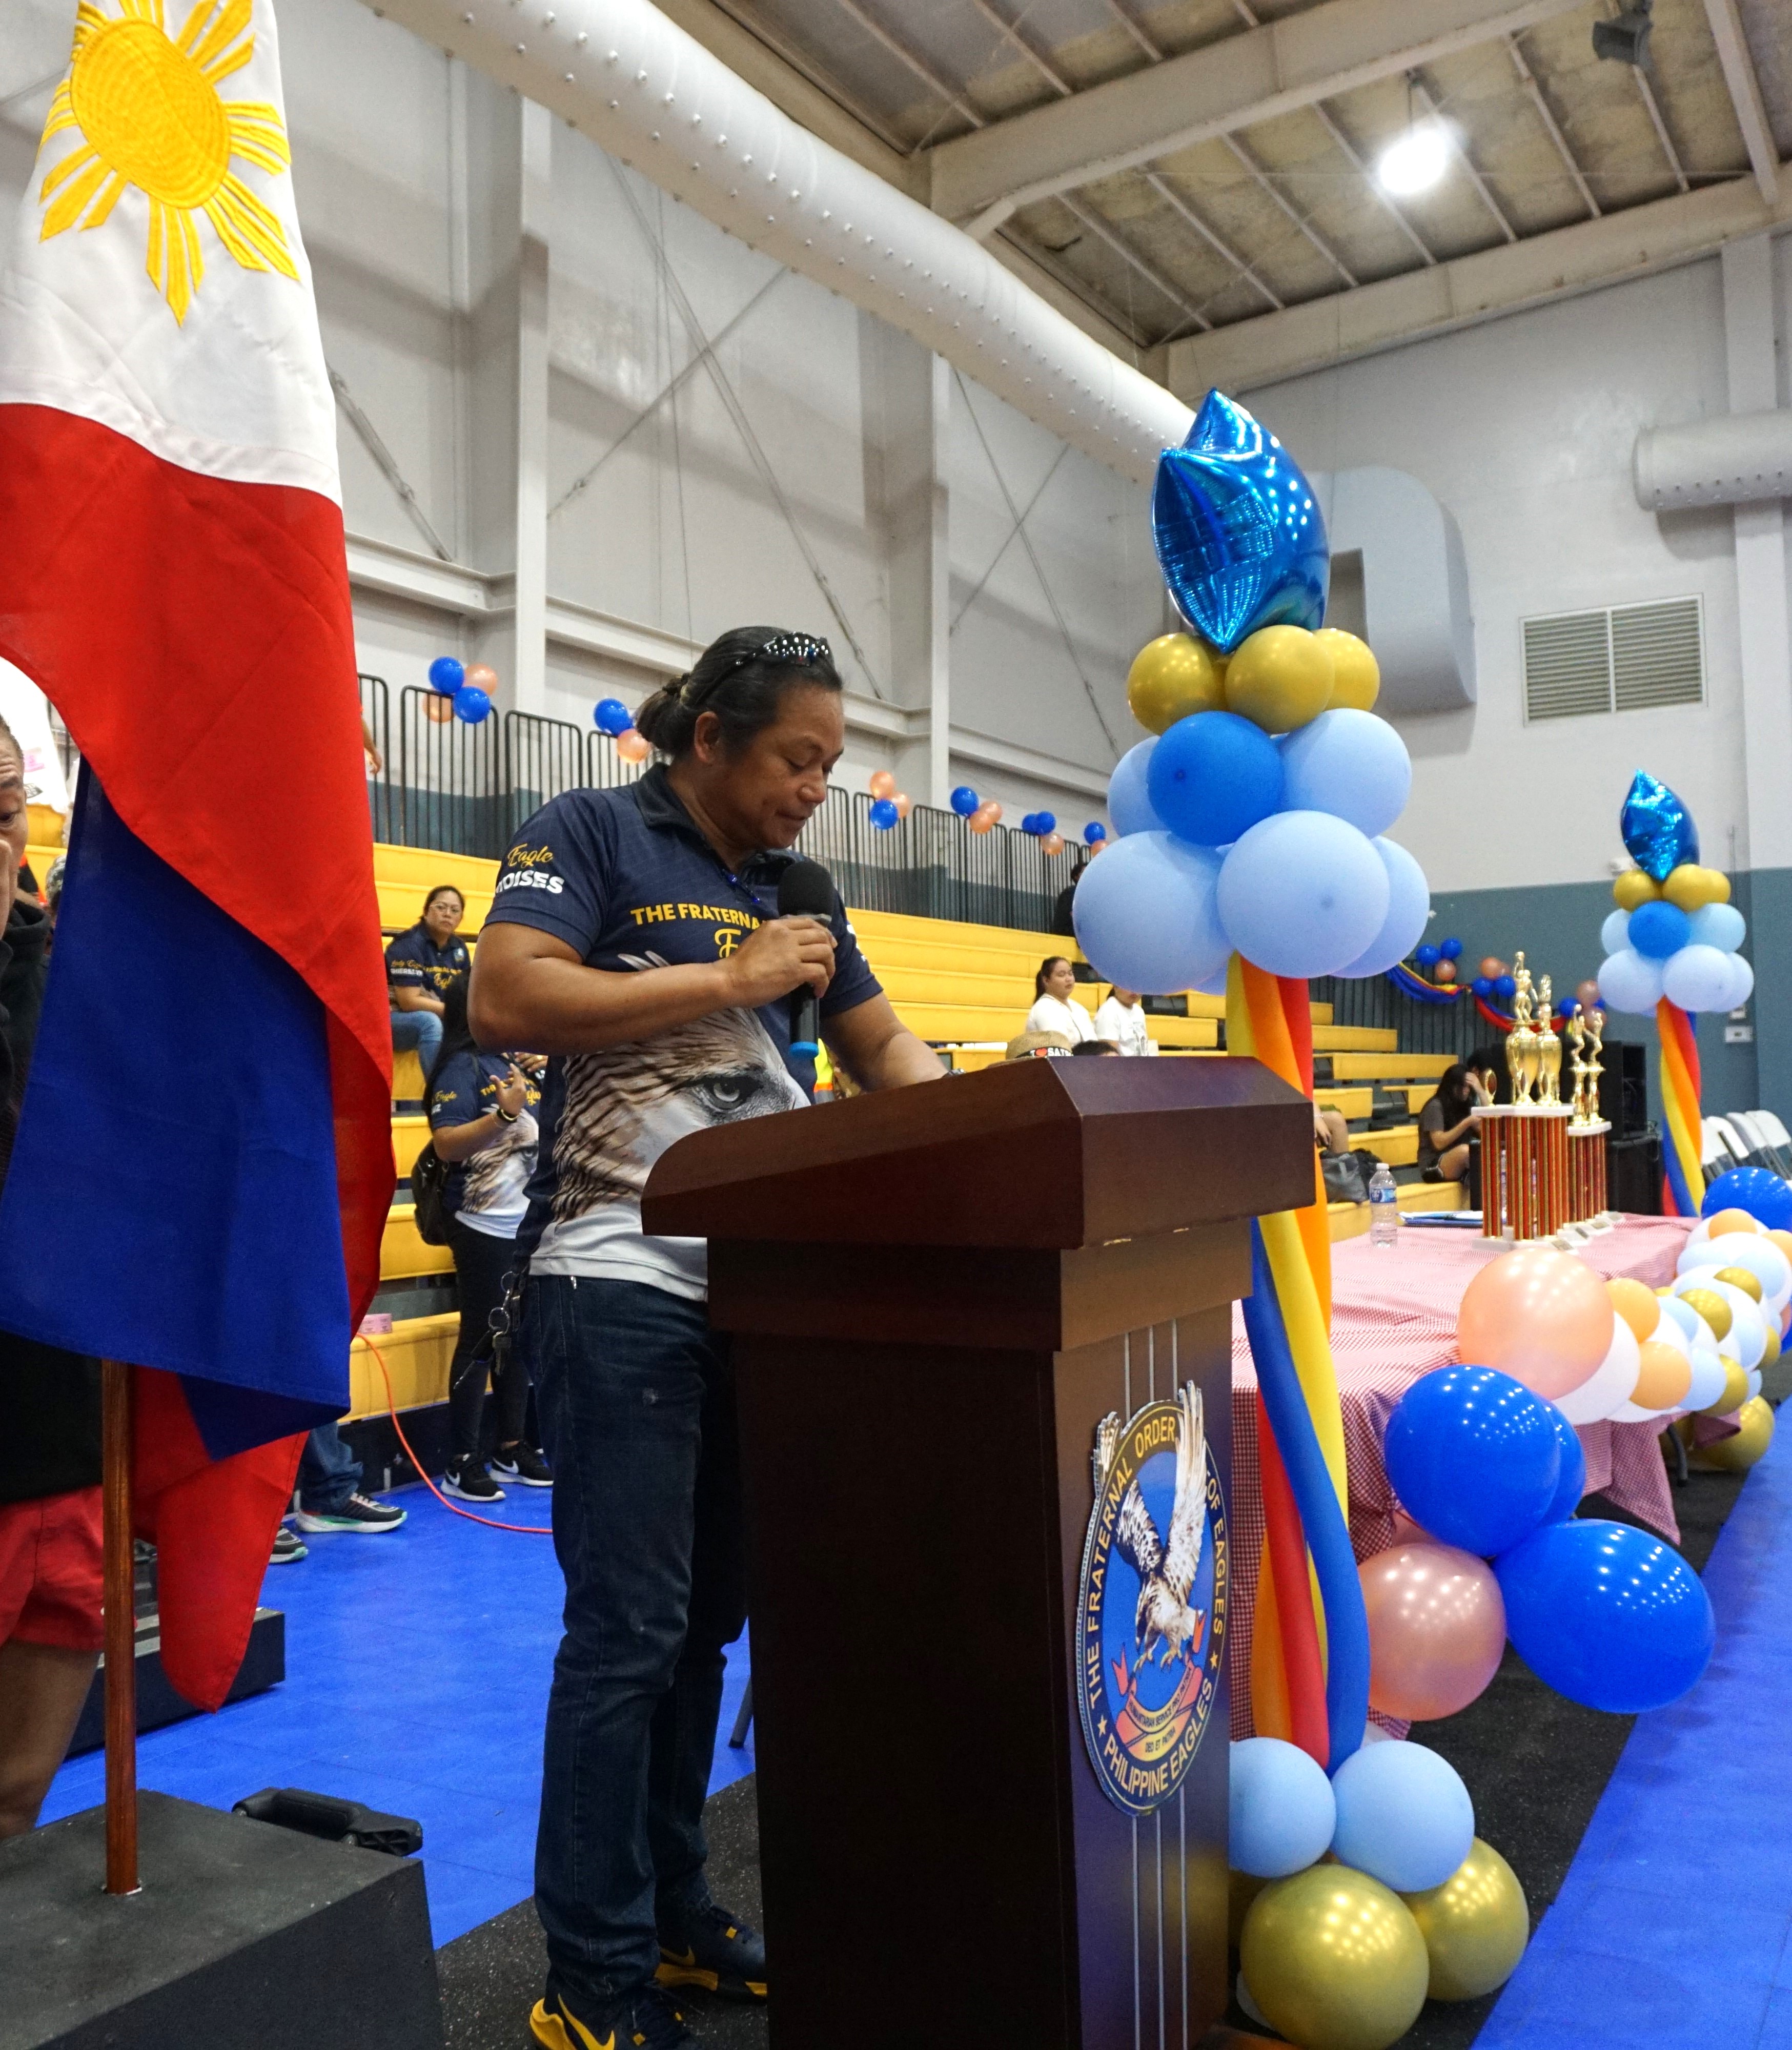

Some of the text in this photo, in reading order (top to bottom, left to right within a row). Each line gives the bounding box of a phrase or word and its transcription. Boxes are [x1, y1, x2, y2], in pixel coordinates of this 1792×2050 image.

[507, 843, 554, 869] Eagle
[630, 904, 760, 930] THE FRATERNA
[1087, 1416, 1226, 1709] THE FRATERNAL ORDER OF EAGLES
[1104, 1677, 1212, 1797] PHILIPPINE EAGLES
